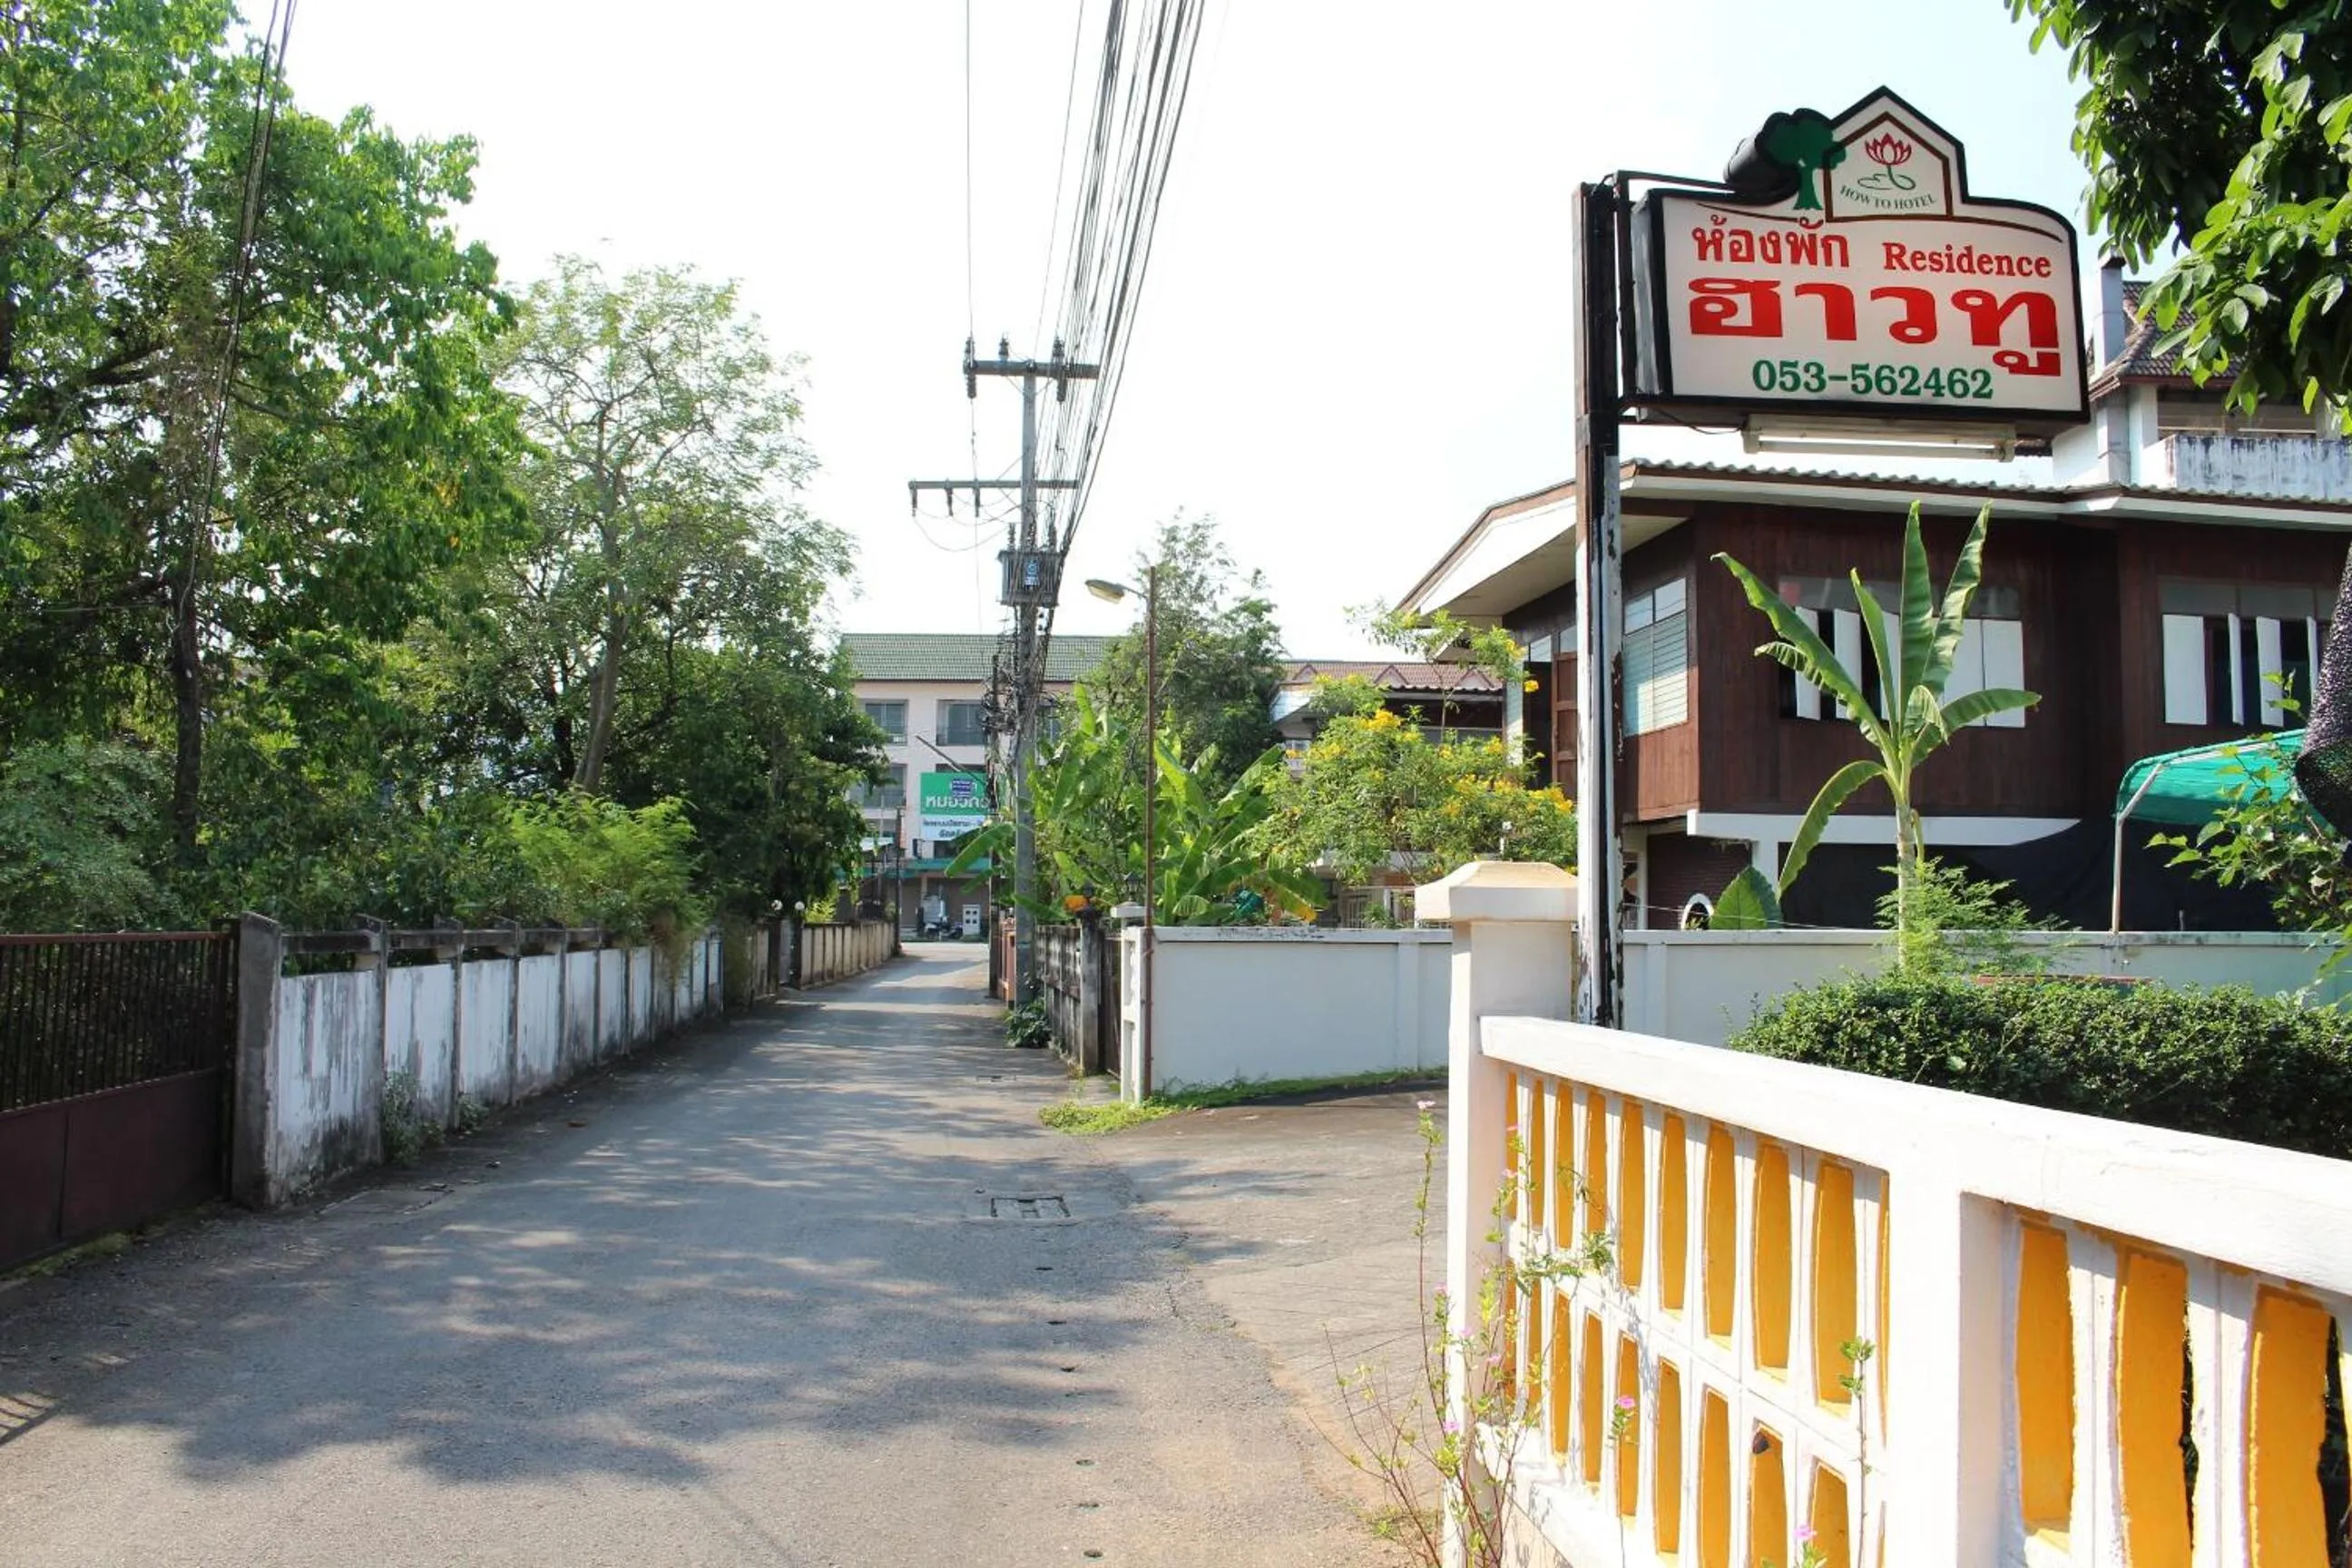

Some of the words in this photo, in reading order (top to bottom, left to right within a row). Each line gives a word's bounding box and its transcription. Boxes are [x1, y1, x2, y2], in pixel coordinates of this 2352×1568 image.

[1840, 184, 1869, 204] HOW
[1871, 196, 1892, 210] TO
[1894, 193, 1936, 210] HOTEL
[1691, 214, 1849, 268] ห้องพัก
[1883, 241, 2052, 278] Residence
[1688, 276, 2061, 377] ฮาวทู
[1752, 359, 1994, 399] 053-562462
